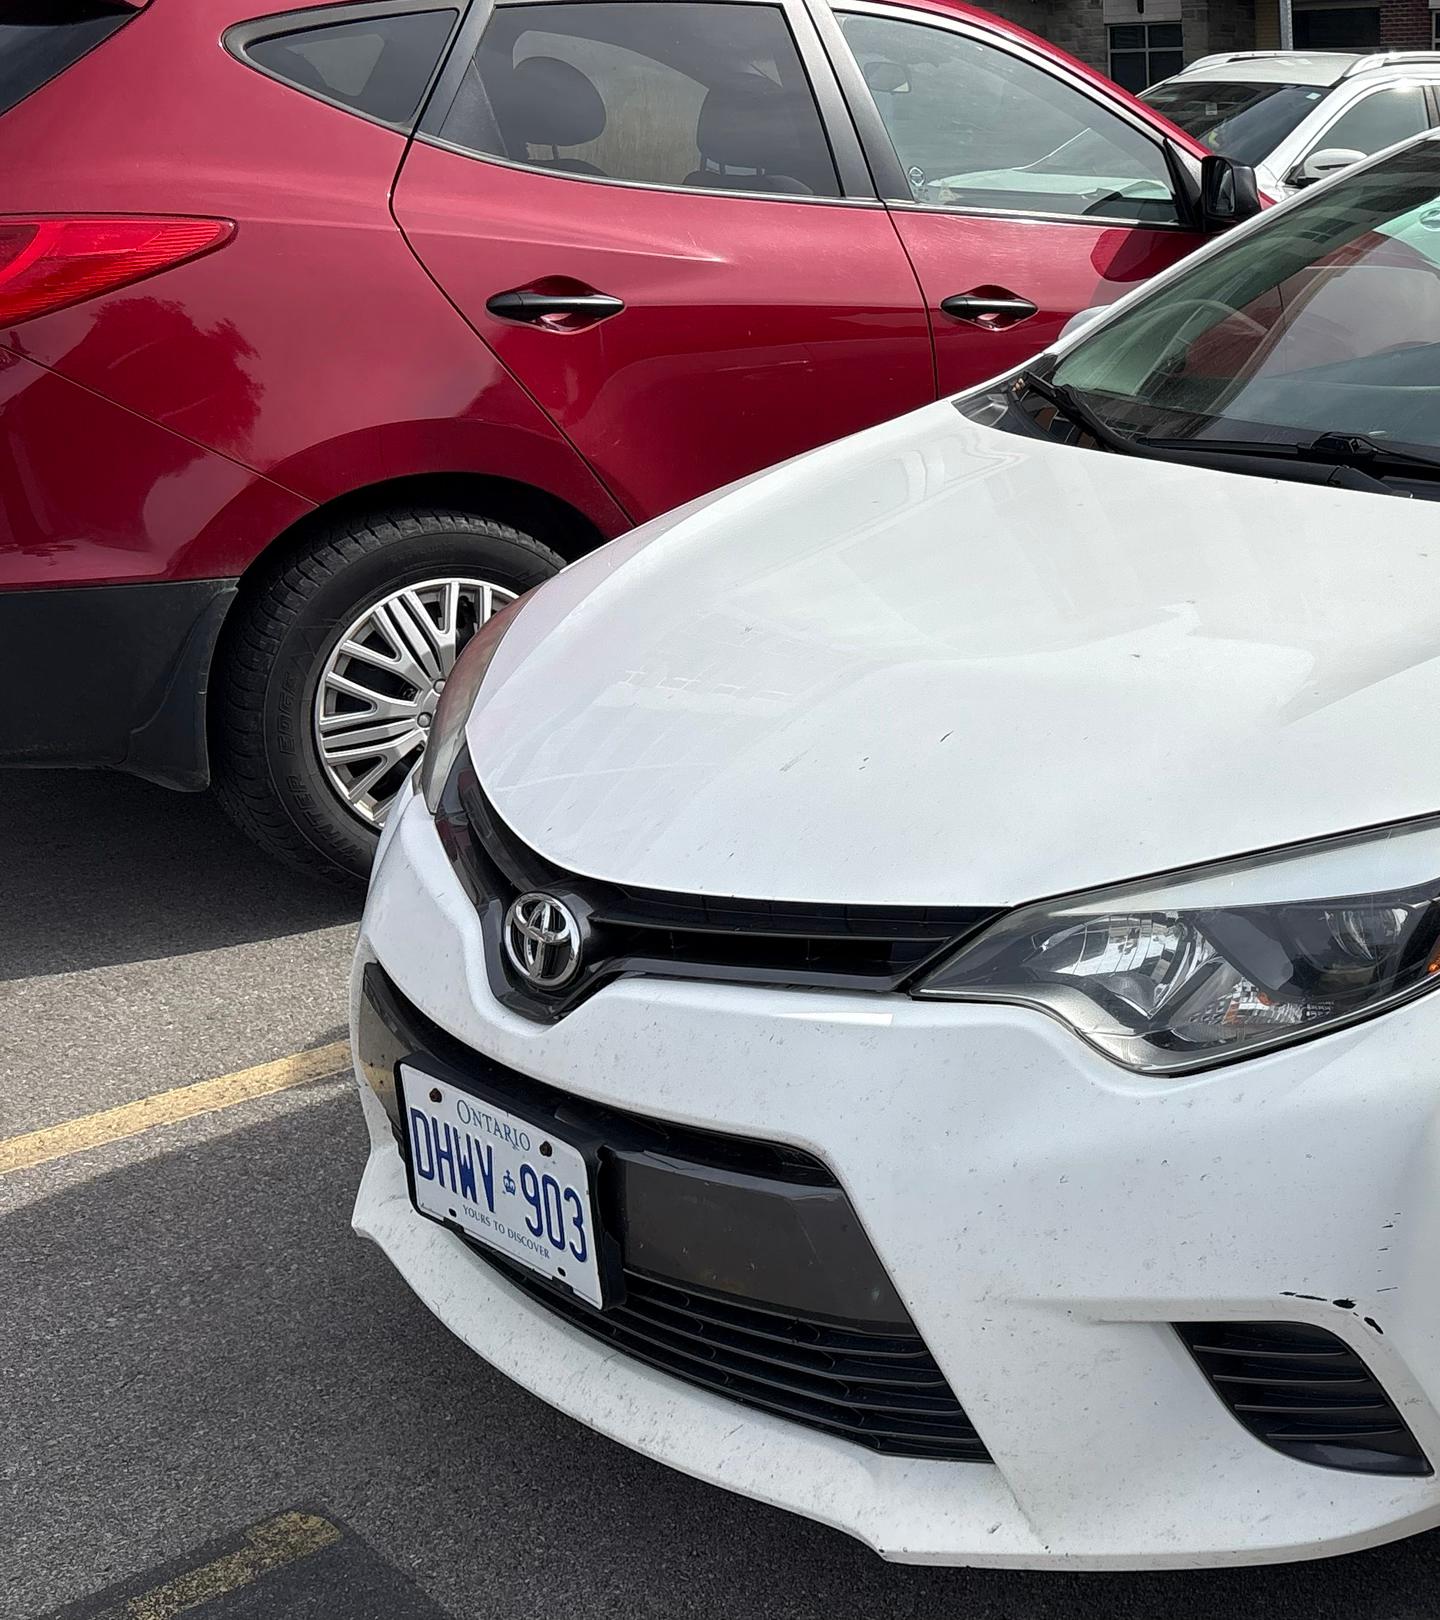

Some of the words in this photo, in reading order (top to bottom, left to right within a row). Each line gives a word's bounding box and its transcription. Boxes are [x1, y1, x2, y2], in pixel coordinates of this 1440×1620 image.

[456, 1099, 531, 1152] ONTARIO
[410, 1107, 495, 1213] DHWV
[519, 1163, 588, 1263] 903
[462, 1204, 491, 1228] YOURS
[492, 1220, 506, 1235] TO
[507, 1229, 550, 1260] DISCOVER
